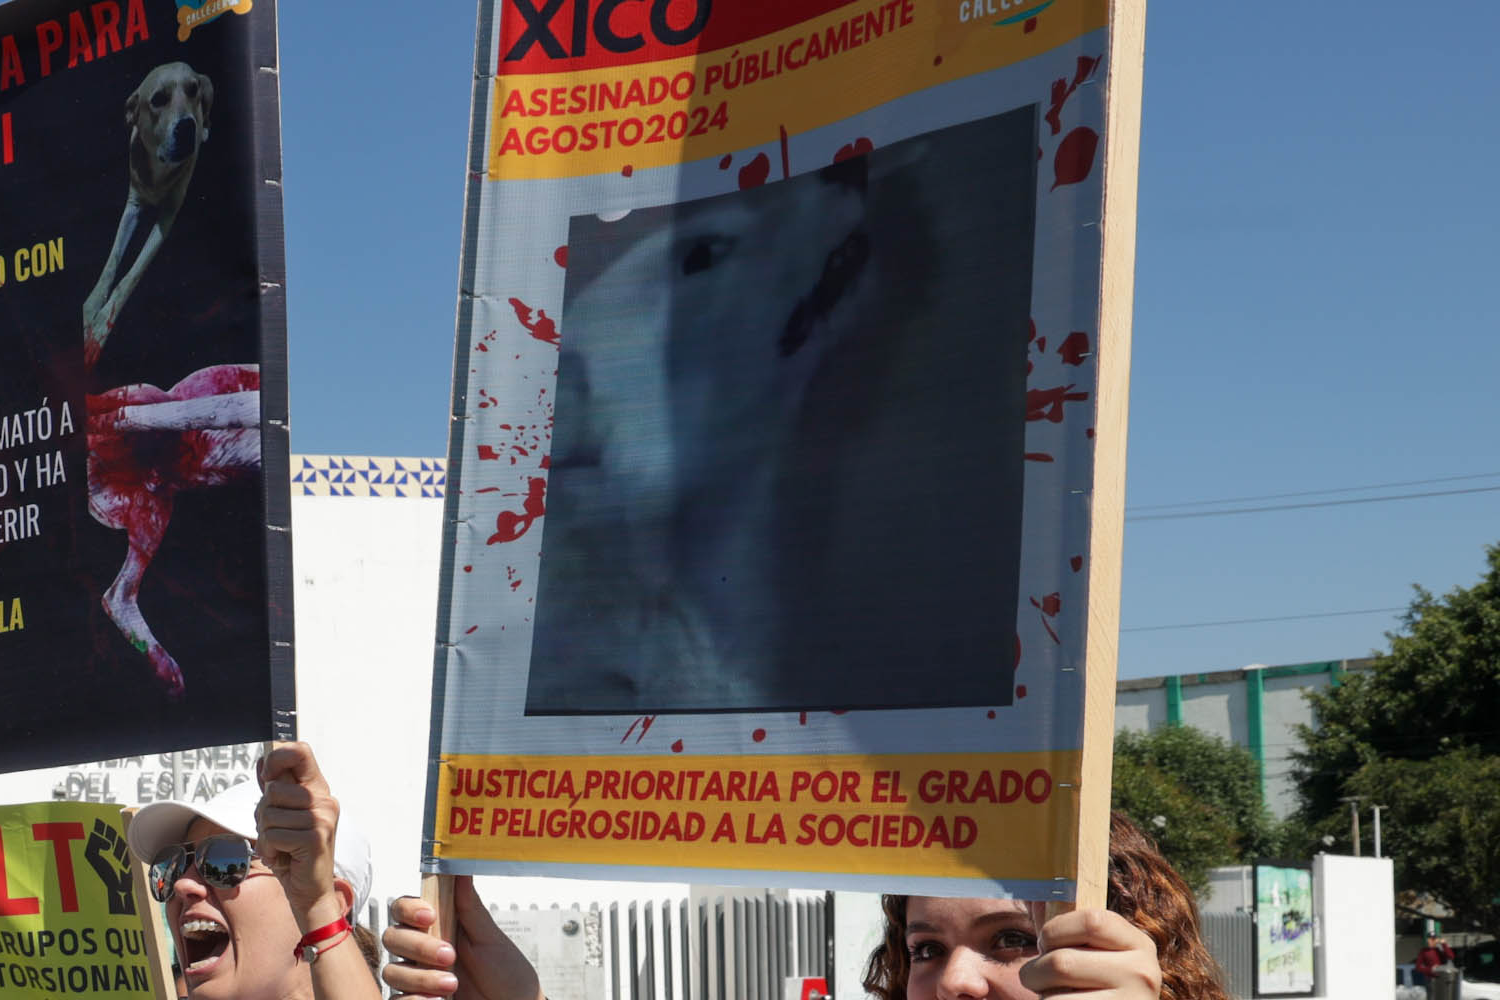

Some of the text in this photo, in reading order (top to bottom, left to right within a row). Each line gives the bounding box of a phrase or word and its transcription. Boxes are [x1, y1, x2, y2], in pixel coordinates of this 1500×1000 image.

[36, 0, 150, 78] PARA
[504, 0, 713, 62] XICO
[500, 0, 915, 118] ASESINADO PÚBLICAMENTE
[14, 236, 65, 282] CON
[59, 400, 74, 436] A
[14, 457, 29, 493] Y
[36, 450, 67, 489] HA
[65, 771, 117, 803] DEL
[583, 770, 781, 802] PRIORITARIA
[789, 769, 860, 805] POR
[871, 770, 908, 804] EL
[918, 768, 1053, 805] GRADO
[449, 806, 979, 850] DE PELIGROSIDAD A LA SOCIEDAD
